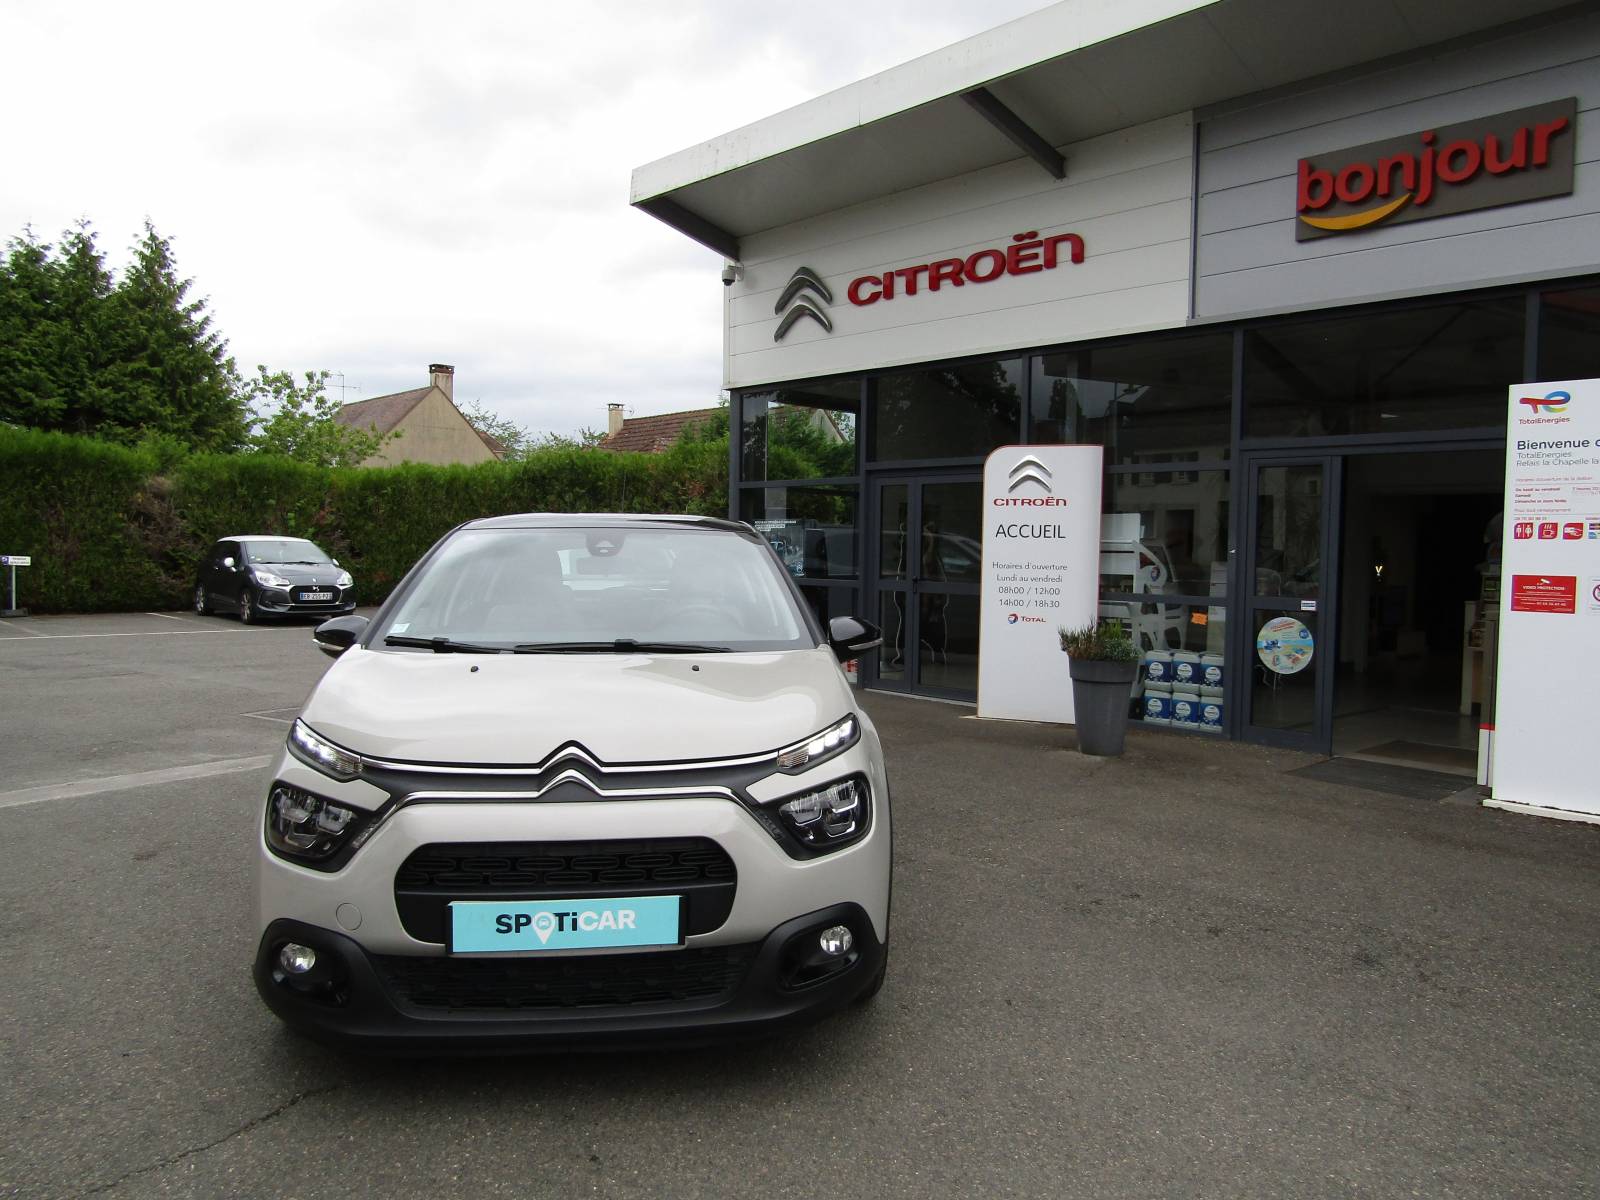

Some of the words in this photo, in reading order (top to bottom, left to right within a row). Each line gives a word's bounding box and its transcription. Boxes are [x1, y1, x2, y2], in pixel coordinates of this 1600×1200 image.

[1297, 116, 1569, 212] bonjour
[1519, 416, 1570, 425] TotalEnergies
[1517, 439, 1590, 450] Bienvenue
[1516, 459, 1540, 467] Relais
[1552, 458, 1590, 466] Chapelle
[995, 524, 1066, 539] ACCUEIL
[992, 561, 1023, 570] Horaires
[1024, 561, 1068, 571] d'ouverture
[996, 573, 1018, 582] Lundi
[1030, 574, 1063, 583] vendredi
[998, 586, 1025, 595] 08h00
[1026, 586, 1032, 595] /
[1034, 586, 1061, 596] 12h00
[999, 598, 1025, 607] 14h00
[1026, 599, 1032, 609] /
[1034, 599, 1060, 608] 18h30
